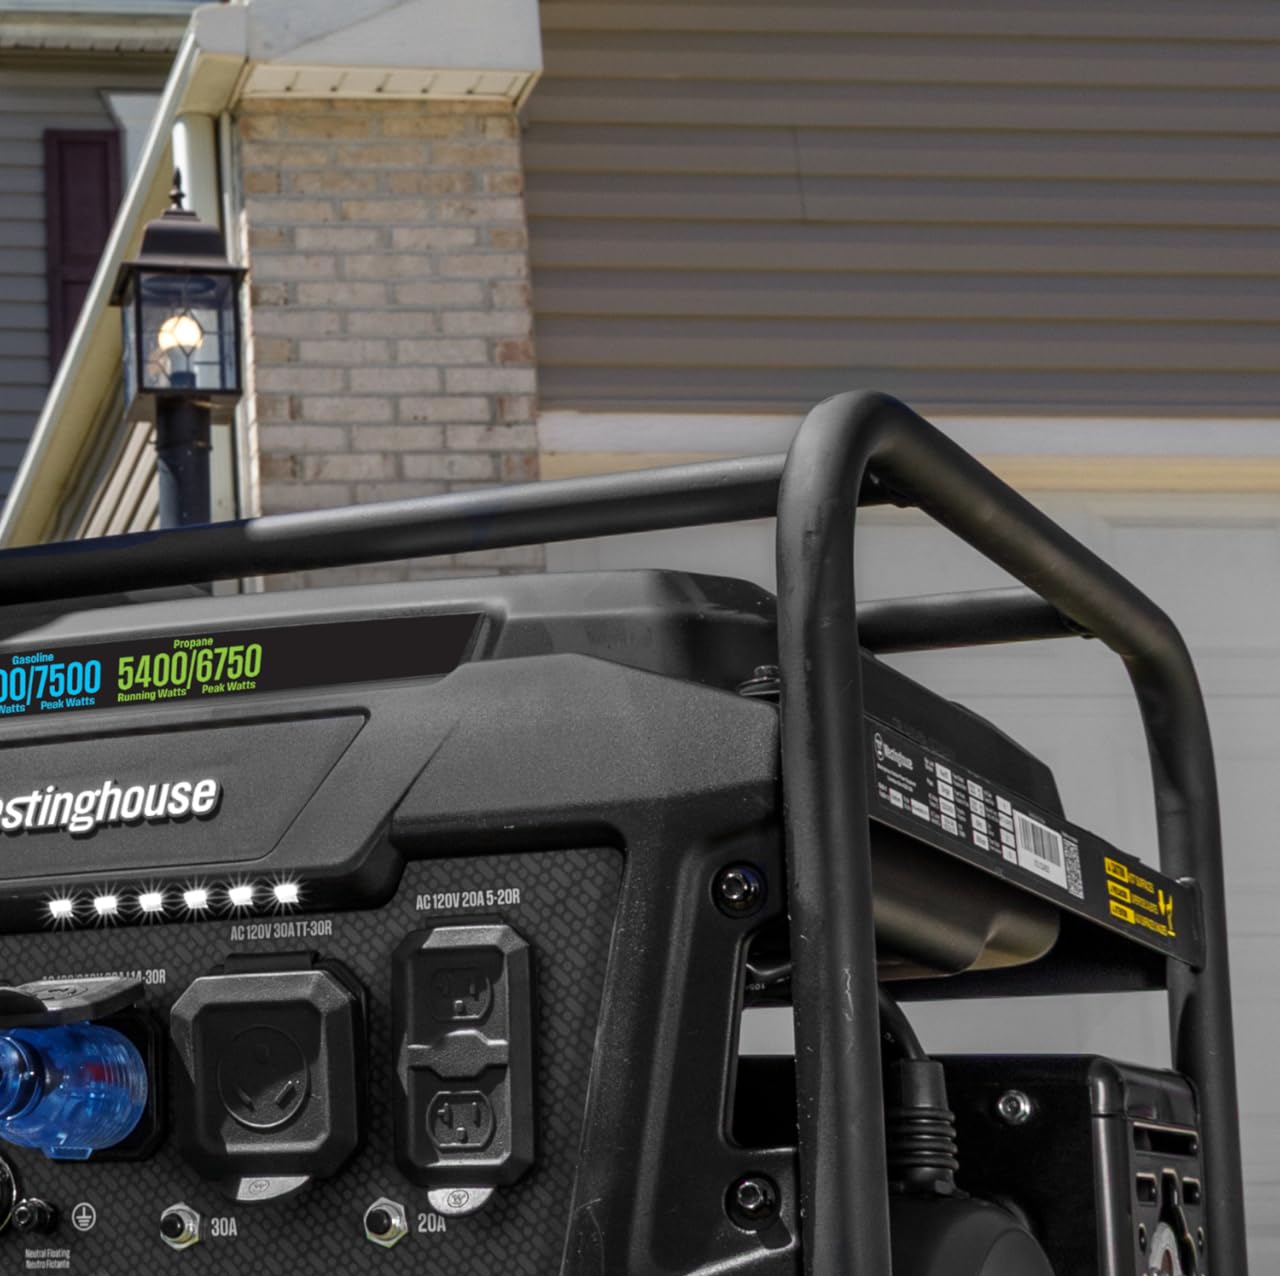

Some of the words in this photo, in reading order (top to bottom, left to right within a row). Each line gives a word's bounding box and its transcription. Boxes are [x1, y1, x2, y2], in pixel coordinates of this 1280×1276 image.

[173, 638, 214, 652] Propane
[12, 652, 55, 667] Gasoline
[117, 643, 263, 691] 5400/6750
[117, 690, 157, 703] Running
[158, 687, 188, 699] Watts
[202, 683, 226, 695] Peak
[227, 680, 257, 692] Watts
[40, 699, 64, 712] Peak
[66, 696, 96, 709] Watts
[416, 893, 431, 911] AC
[432, 891, 460, 909] 120V
[461, 890, 485, 908] 20A
[486, 888, 520, 906] 5-20R
[230, 925, 245, 941] AC
[246, 923, 272, 940] 120V
[211, 1217, 238, 1237] 30A
[418, 1214, 447, 1233] 20A
